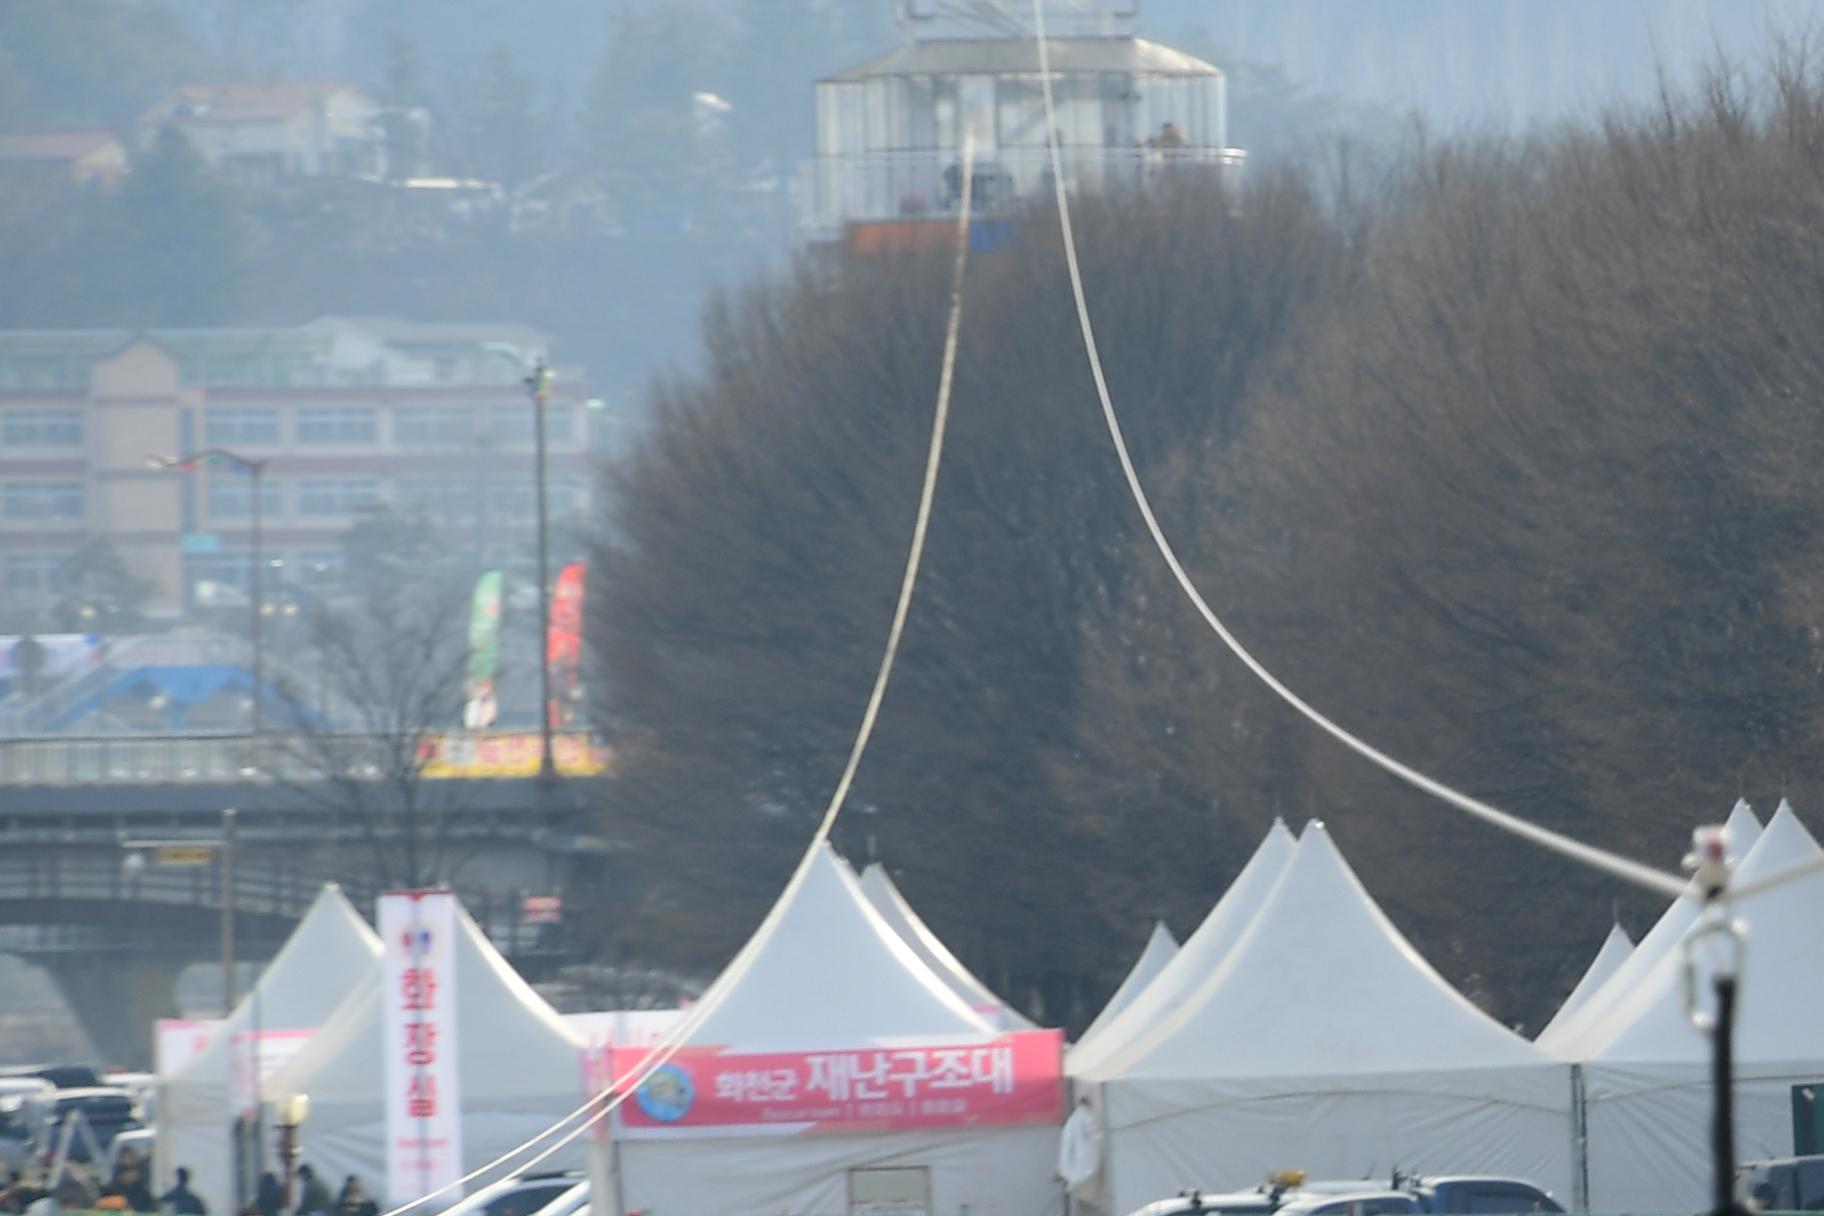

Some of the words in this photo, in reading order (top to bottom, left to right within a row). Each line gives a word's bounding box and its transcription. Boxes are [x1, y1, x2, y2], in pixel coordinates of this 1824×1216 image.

[401, 968, 438, 1118] 화장실
[715, 1068, 797, 1102] 화천군
[805, 1046, 1015, 1101] 재난구조대
